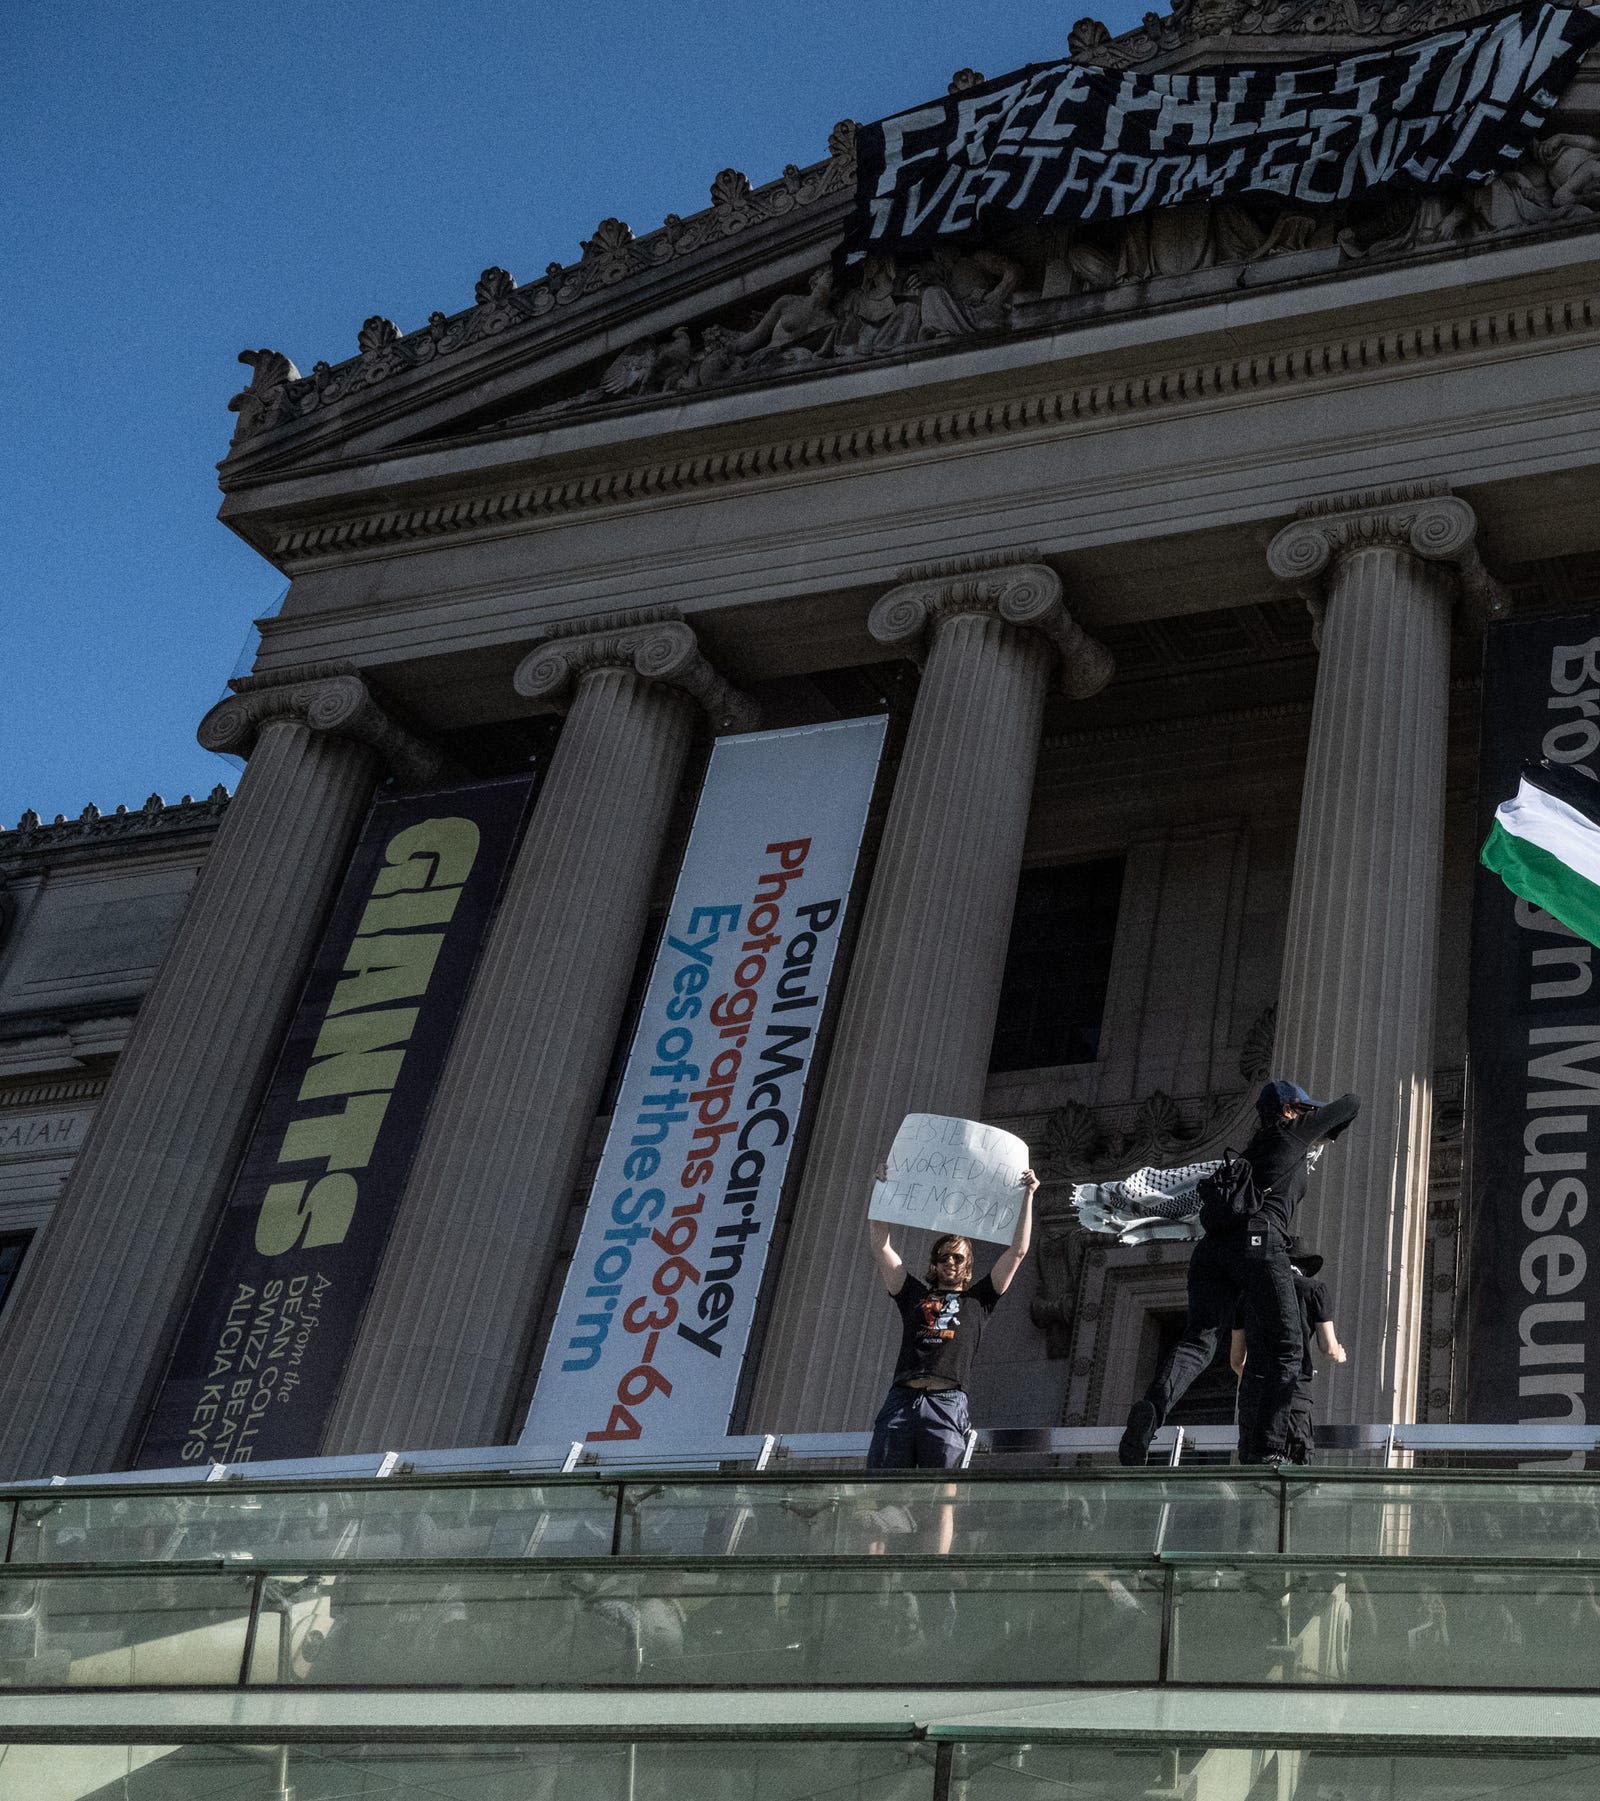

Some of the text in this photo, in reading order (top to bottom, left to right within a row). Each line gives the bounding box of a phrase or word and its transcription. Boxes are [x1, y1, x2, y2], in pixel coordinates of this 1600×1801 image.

[876, 64, 1094, 197] FREE
[1043, 147, 1246, 219] FROM
[667, 903, 742, 1021] Eyes
[681, 836, 812, 1188] Photographs
[255, 816, 480, 1257] GIANTS
[677, 898, 842, 1358] Paul McCartney
[893, 1147, 985, 1181] WORKED
[876, 1179, 1016, 1230] THE MOSSAD
[239, 1279, 284, 1373] SWIZZ
[268, 1275, 309, 1359] DEAN
[277, 1272, 333, 1403] Art from the
[561, 1186, 666, 1372] Storm
[181, 1283, 256, 1460] ALICIA KEYS
